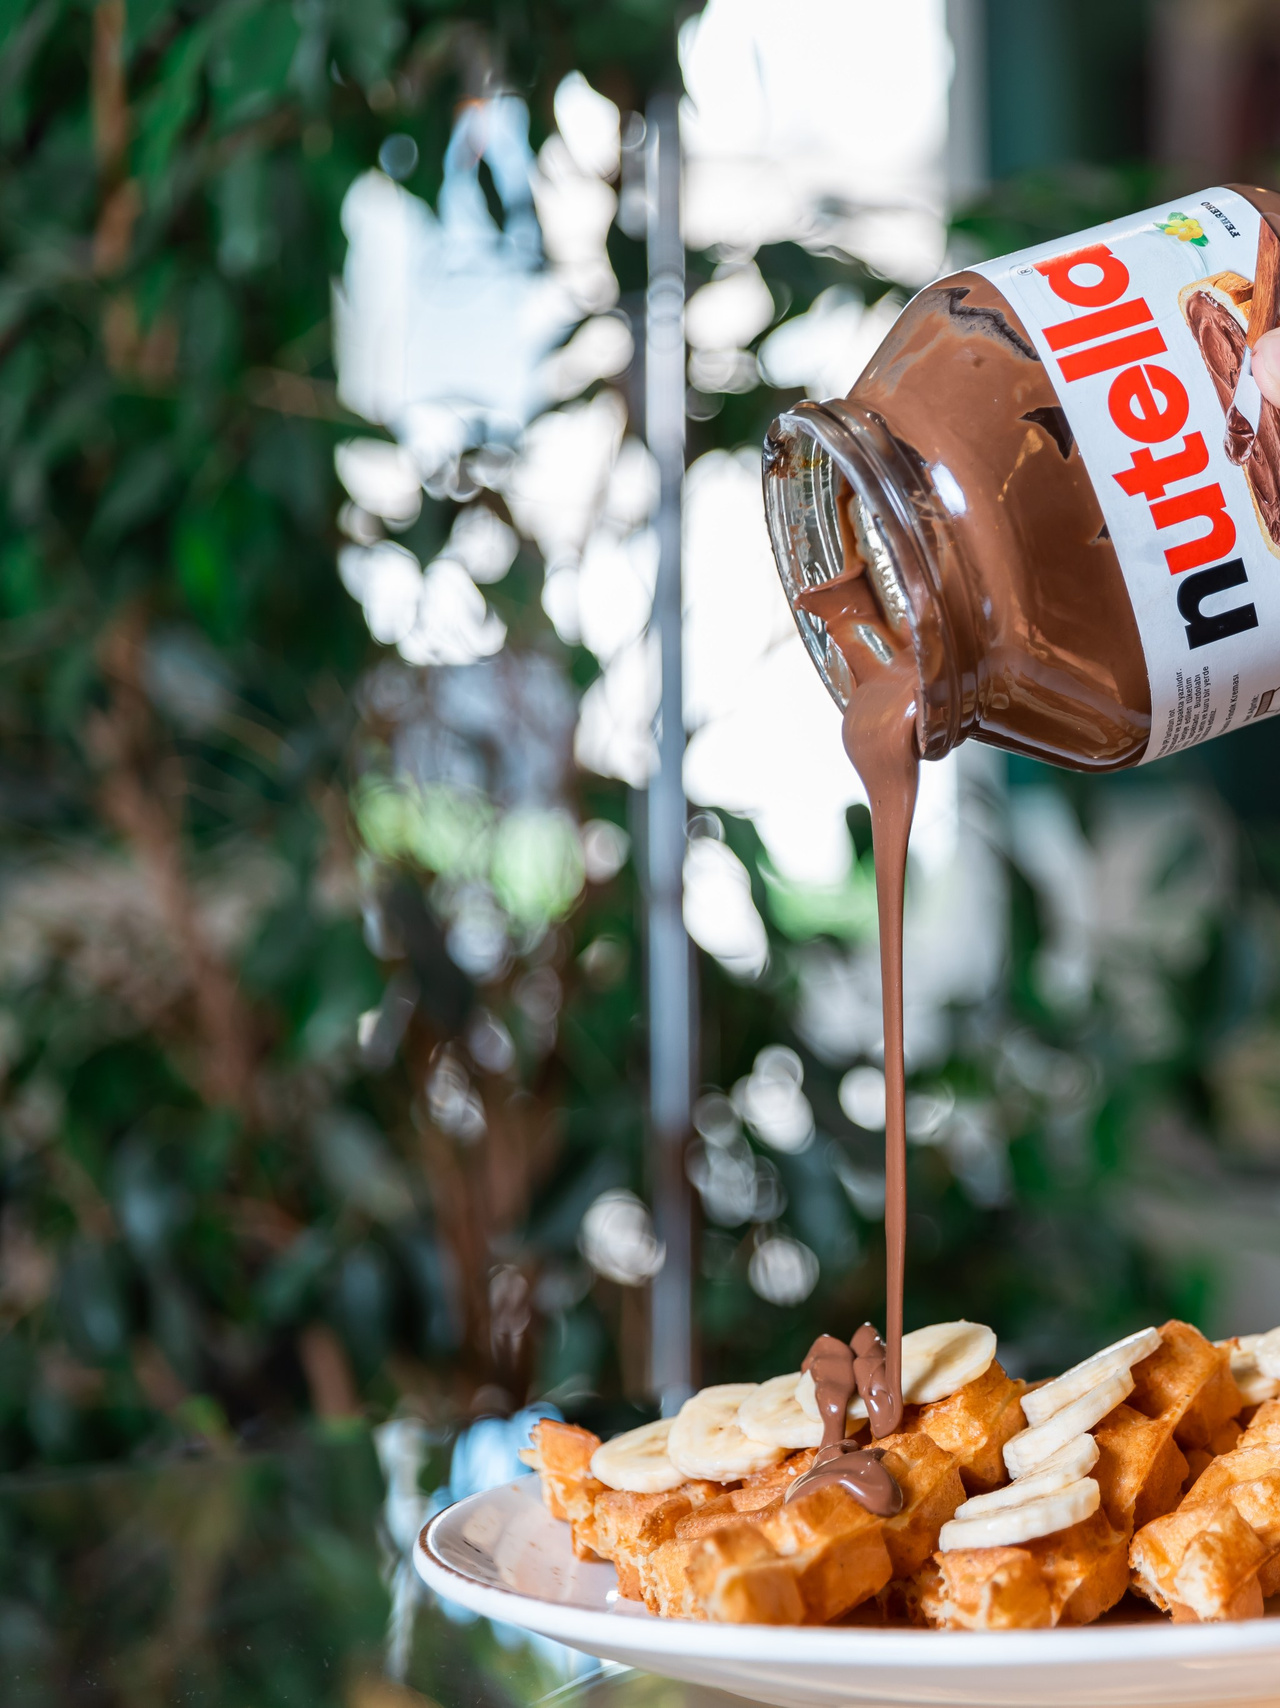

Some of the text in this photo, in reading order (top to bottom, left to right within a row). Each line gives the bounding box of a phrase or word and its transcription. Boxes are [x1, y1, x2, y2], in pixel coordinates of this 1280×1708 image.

[1201, 201, 1241, 238] FERRERO
[1032, 242, 1259, 650] nutella
[1176, 669, 1186, 700] yazılıdır.
[1185, 677, 1193, 703] tüketim
[1202, 666, 1211, 687] yerde
[1229, 674, 1239, 702] Kreması
[1202, 688, 1210, 698] bir
[1175, 701, 1184, 726] kapakta
